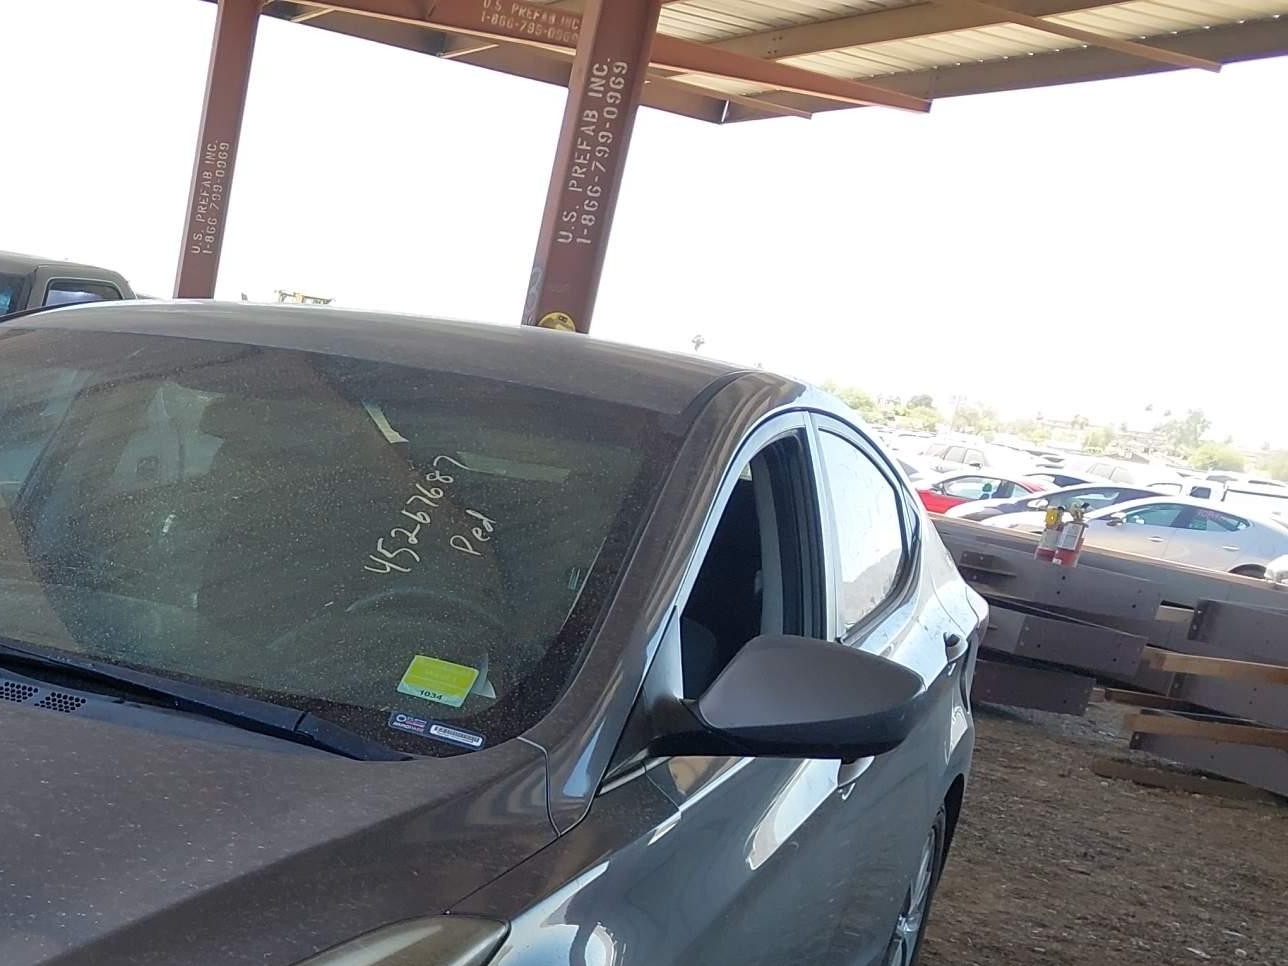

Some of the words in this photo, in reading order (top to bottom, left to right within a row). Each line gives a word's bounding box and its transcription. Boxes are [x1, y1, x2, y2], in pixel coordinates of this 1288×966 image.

[588, 57, 611, 98] INC.
[568, 109, 599, 192] PREFAB
[576, 61, 628, 244] 1-866-799-0969
[196, 171, 213, 222] PREFAB
[557, 205, 581, 243] U.S.
[363, 455, 474, 573] 45267687
[419, 689, 443, 700] 1034
